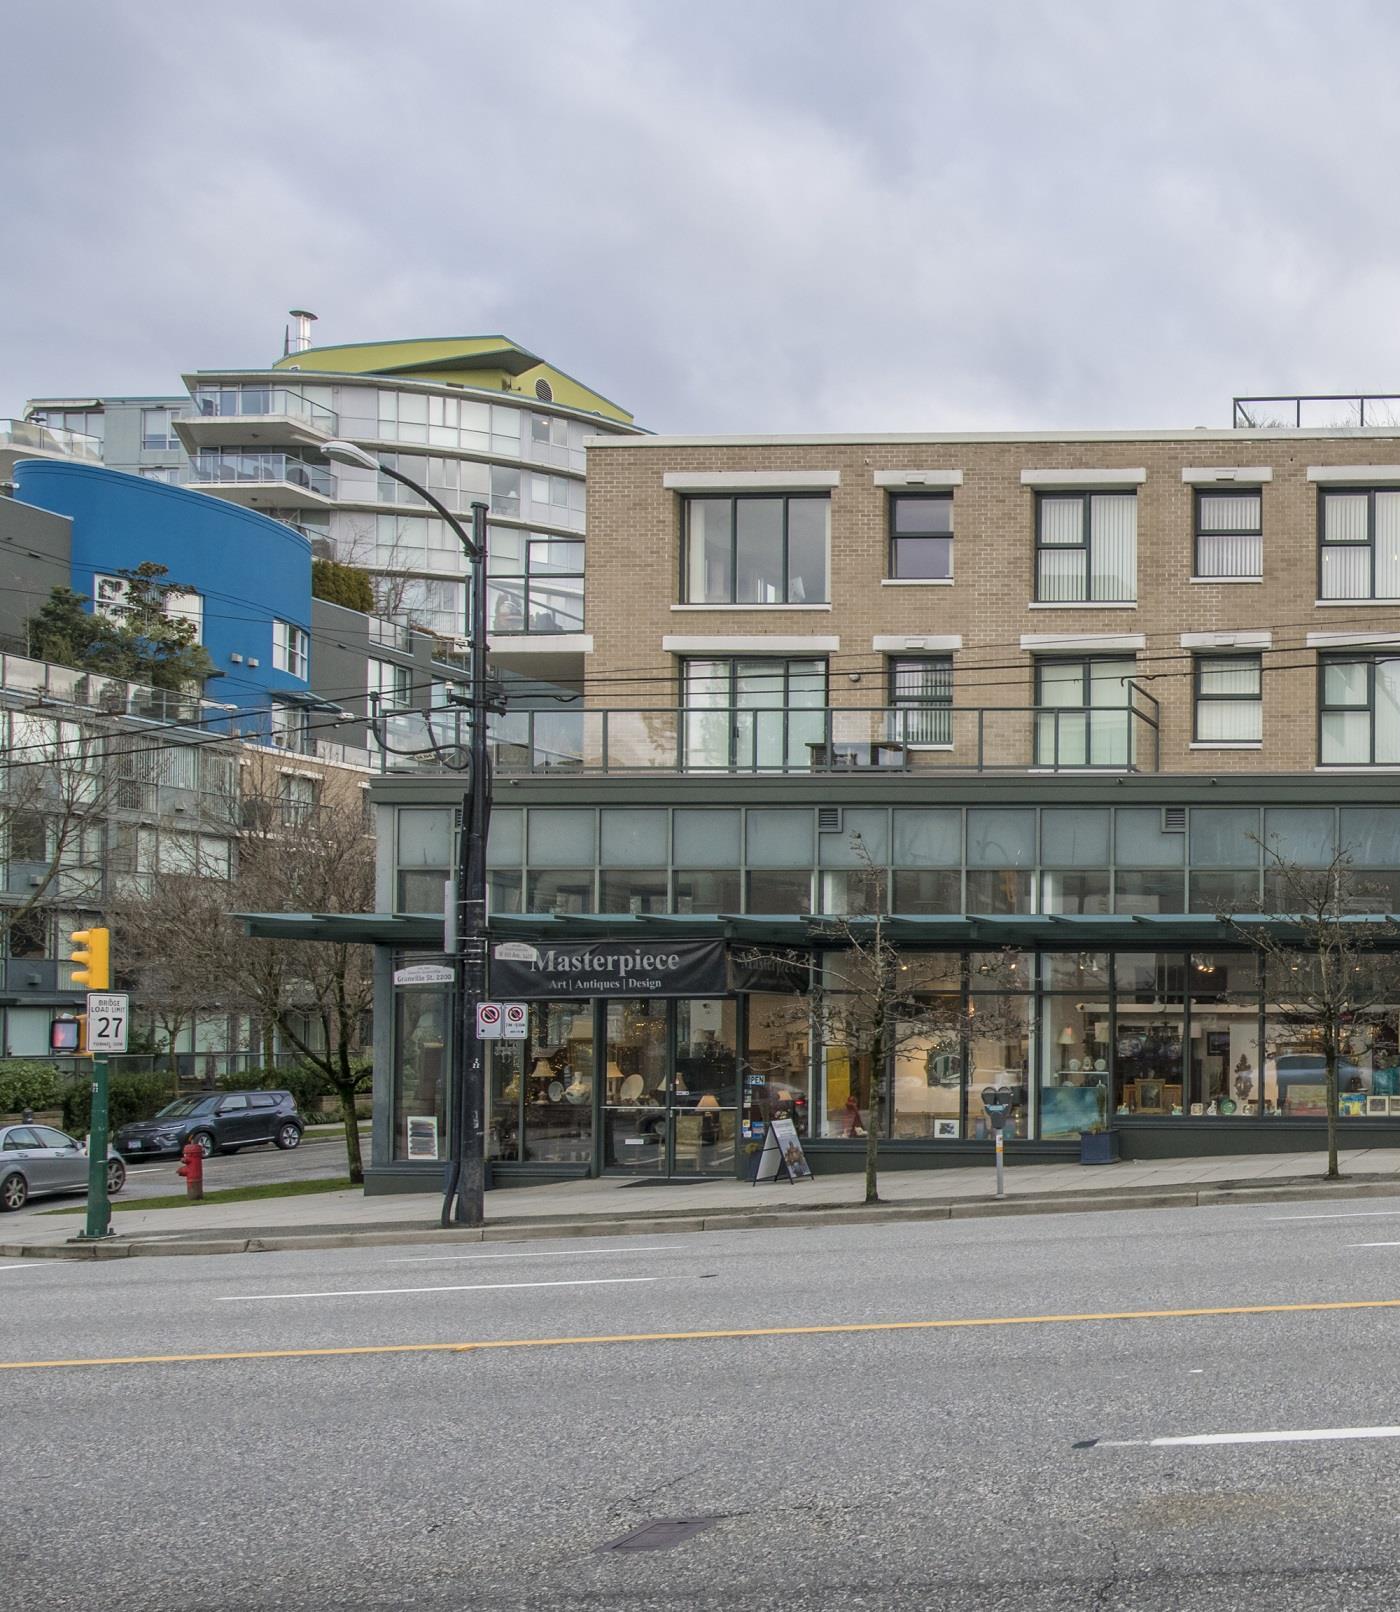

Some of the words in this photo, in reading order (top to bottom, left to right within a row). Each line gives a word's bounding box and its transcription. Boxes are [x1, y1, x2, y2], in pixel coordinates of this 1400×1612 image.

[530, 948, 680, 977] Masterpiece
[549, 980, 567, 989] Art
[575, 979, 620, 991] Antiques
[629, 978, 661, 989] Design
[97, 1016, 123, 1038] 27
